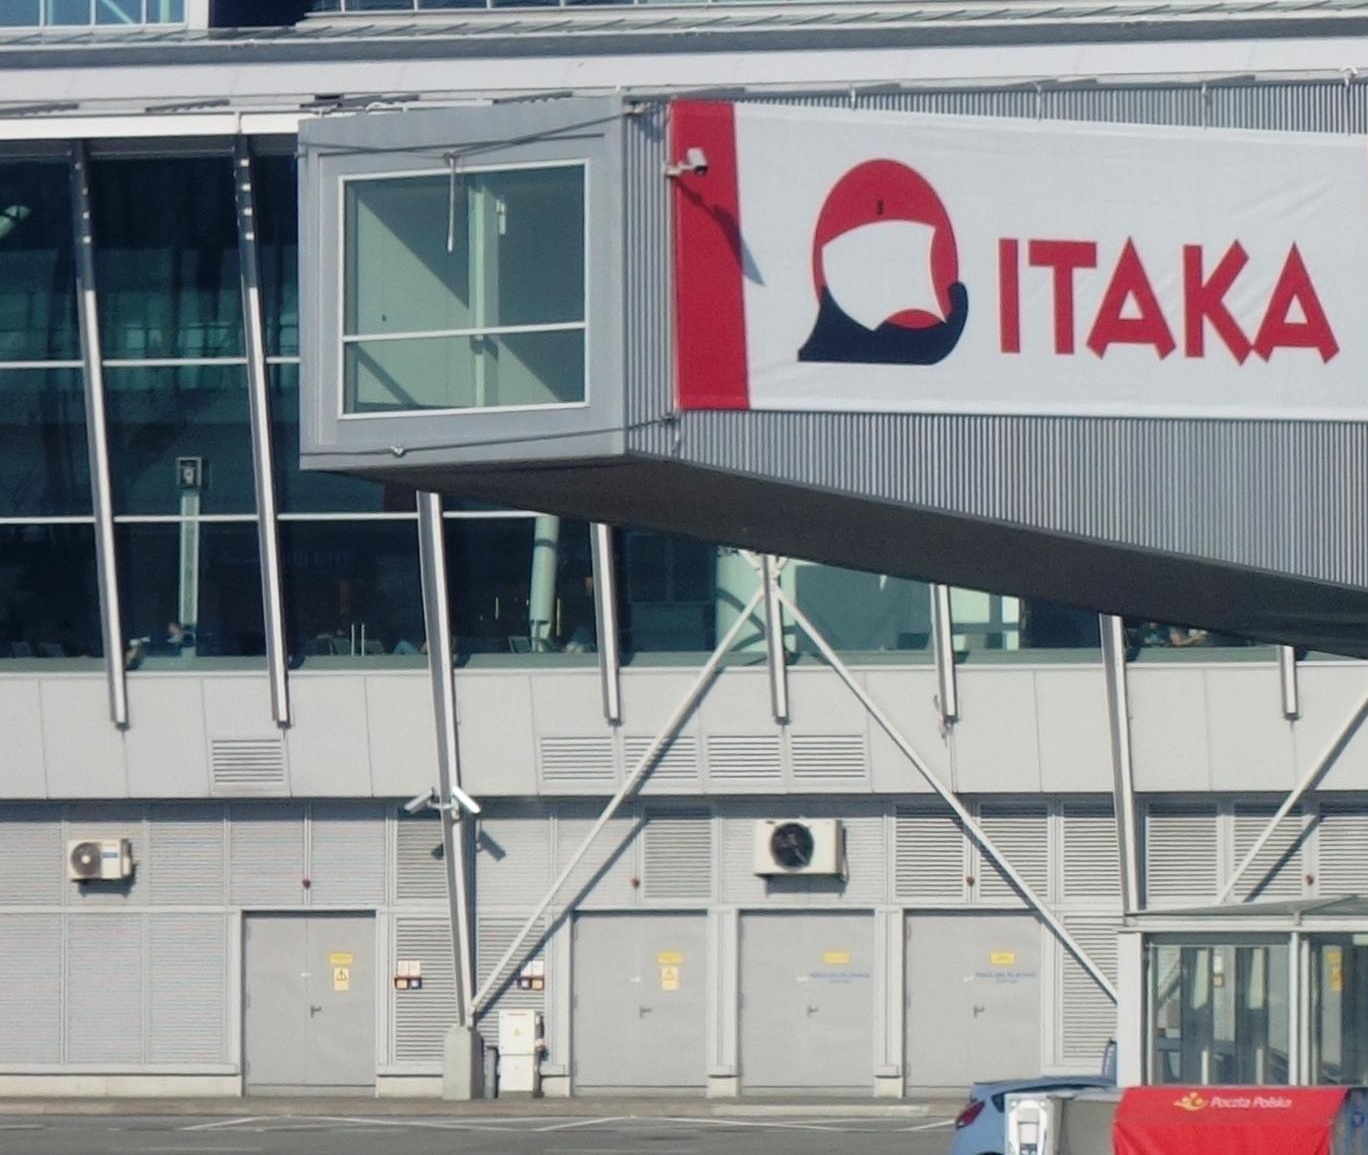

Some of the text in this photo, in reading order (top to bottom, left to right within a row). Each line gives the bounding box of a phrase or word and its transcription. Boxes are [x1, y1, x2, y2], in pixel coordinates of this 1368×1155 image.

[998, 235, 1340, 365] ITAKA
[1210, 1096, 1293, 1109] Poczta Polska
